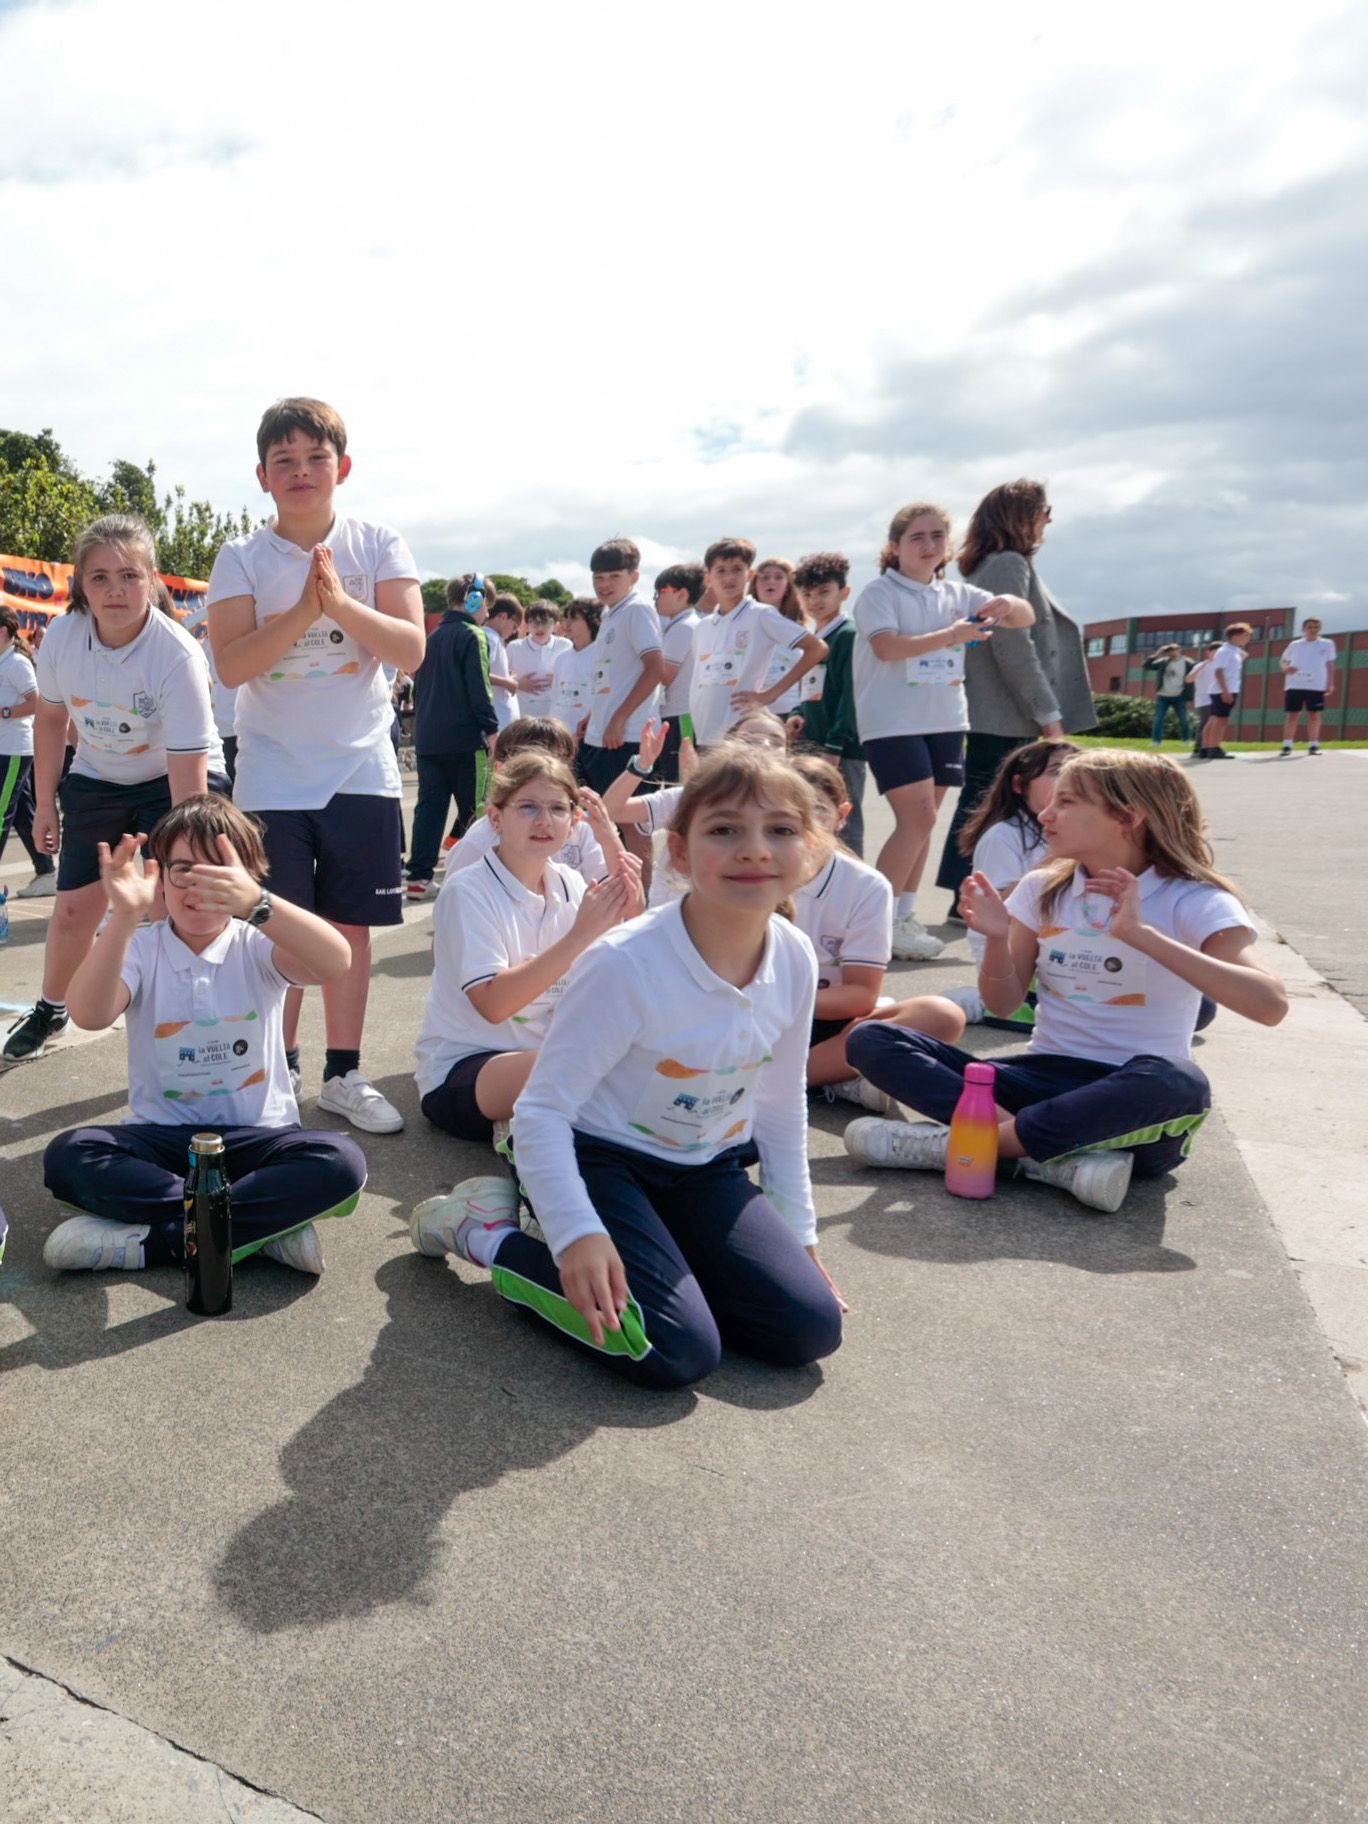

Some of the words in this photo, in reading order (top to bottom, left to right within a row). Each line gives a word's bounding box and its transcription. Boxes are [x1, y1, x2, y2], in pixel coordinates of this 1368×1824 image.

[2, 567, 54, 599] UNO
[1077, 953, 1103, 963] VUELTA
[1079, 961, 1096, 971] COLE
[206, 1042, 231, 1053] VUELTA
[211, 1052, 227, 1062] COLE
